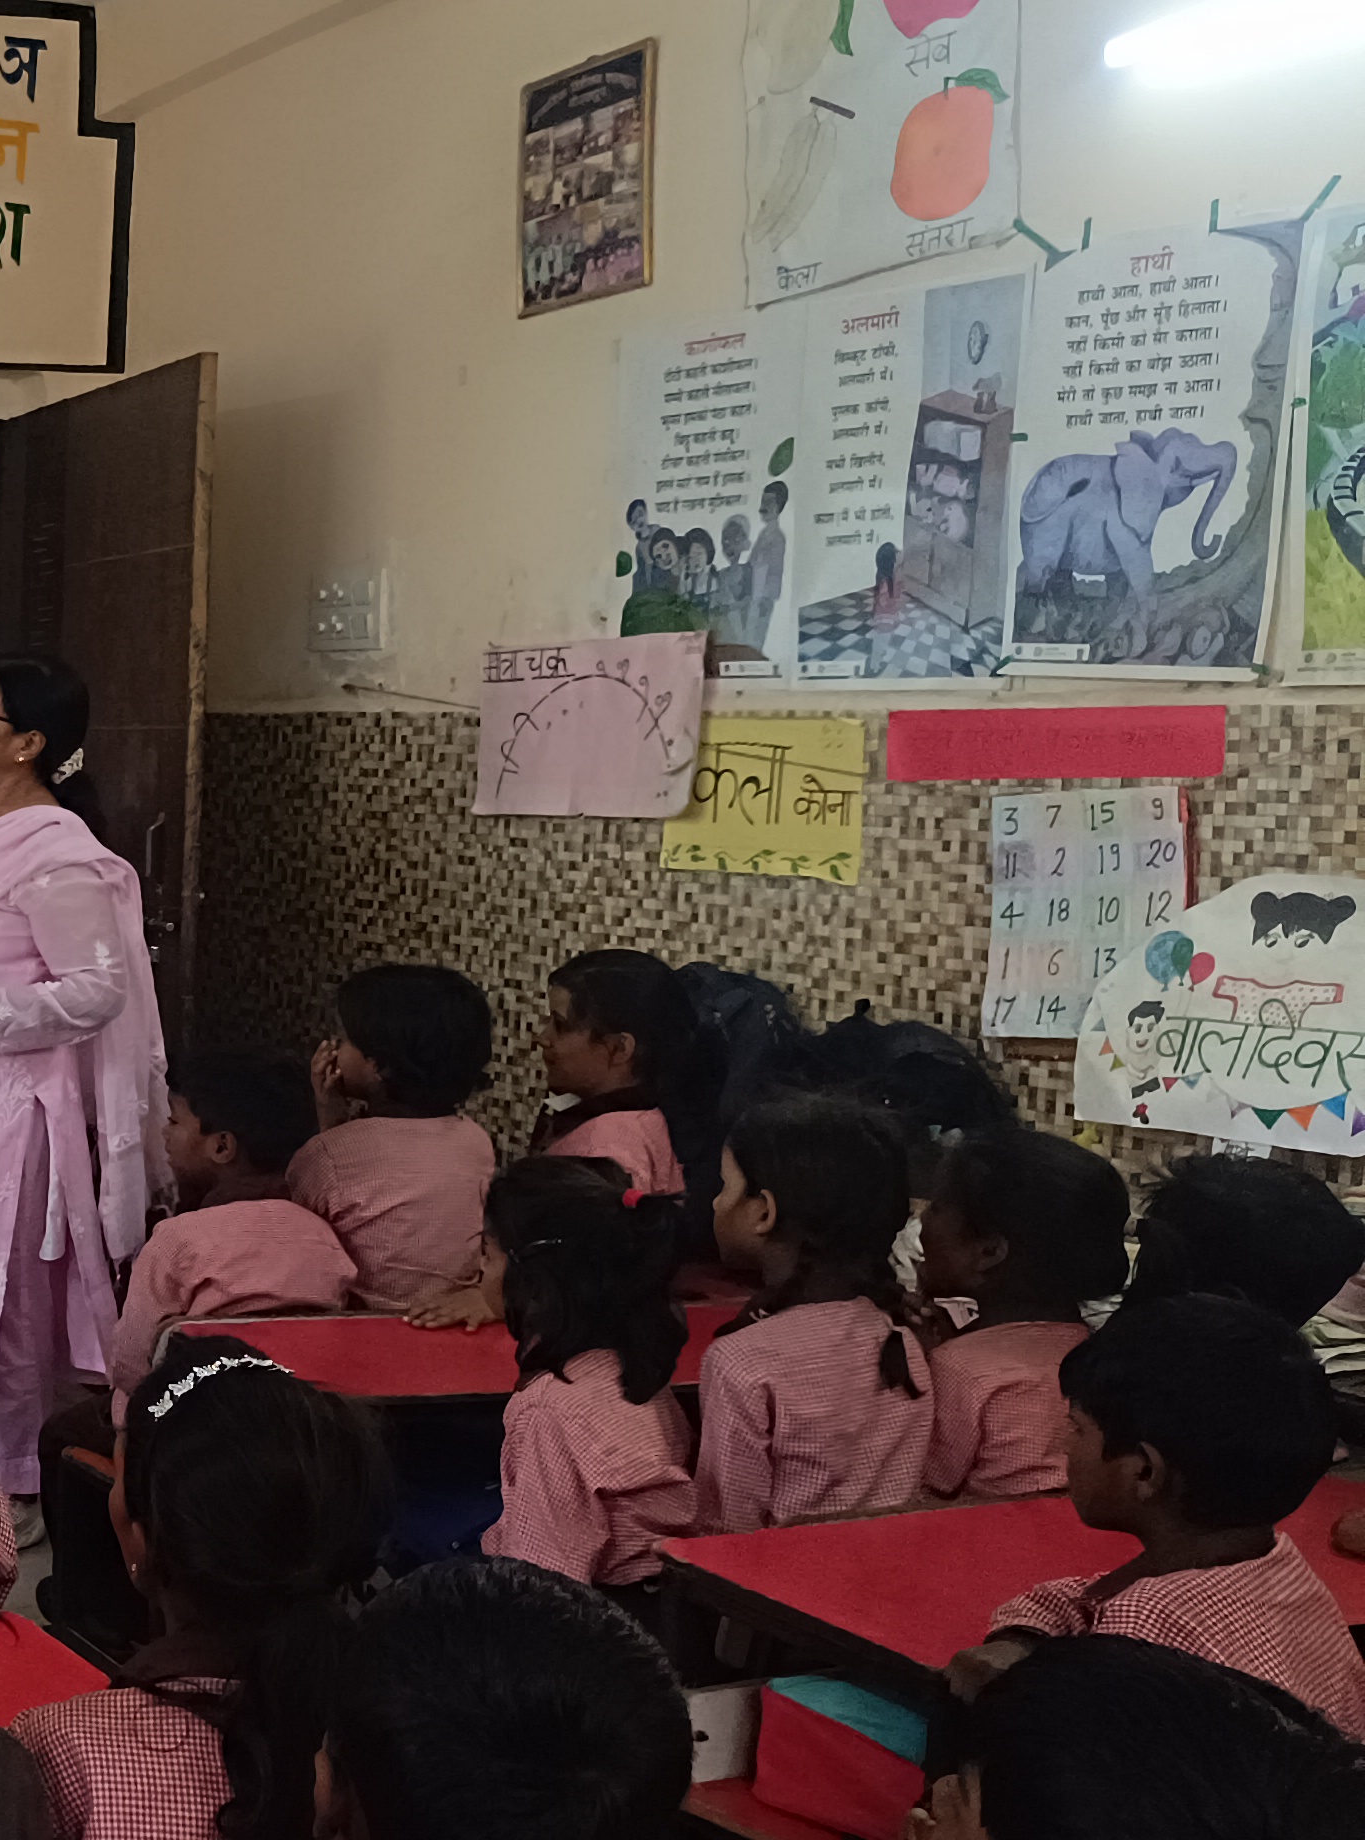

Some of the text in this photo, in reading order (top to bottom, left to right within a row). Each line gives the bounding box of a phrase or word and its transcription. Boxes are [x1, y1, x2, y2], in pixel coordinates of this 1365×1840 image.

[906, 217, 975, 258] संतरा
[1130, 246, 1174, 277] हाथी
[841, 305, 900, 335] अलमारी
[693, 741, 860, 827] कला कोना
[1002, 797, 1165, 835] 3 7 15 9
[1004, 839, 1176, 879] 11 2 19 20
[1000, 890, 1172, 929] 4 18 10 12
[1047, 949, 1060, 976] 6
[1093, 947, 1117, 978] 13
[991, 995, 1066, 1027] 17 14
